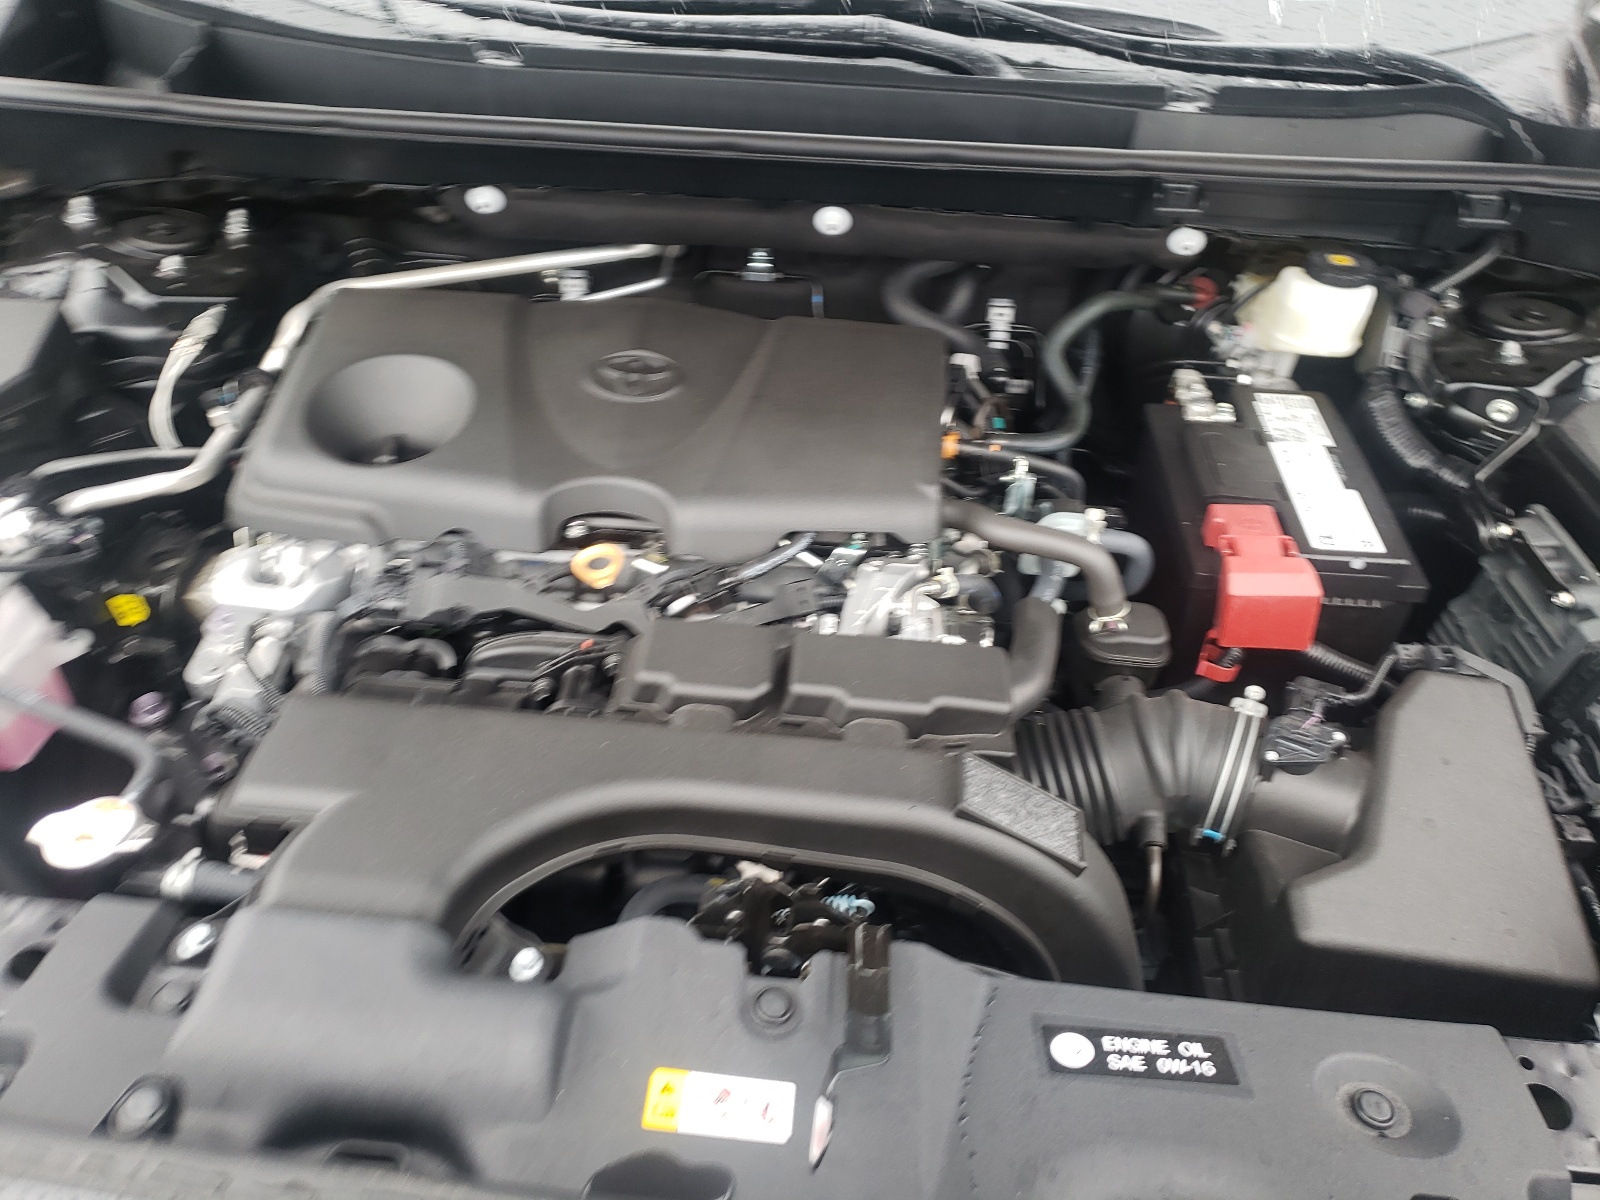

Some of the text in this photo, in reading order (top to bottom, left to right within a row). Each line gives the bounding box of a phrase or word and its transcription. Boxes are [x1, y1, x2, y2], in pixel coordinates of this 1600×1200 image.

[1101, 1035, 1212, 1058] ENGINE OIL
[1106, 1054, 1148, 1072] SAE
